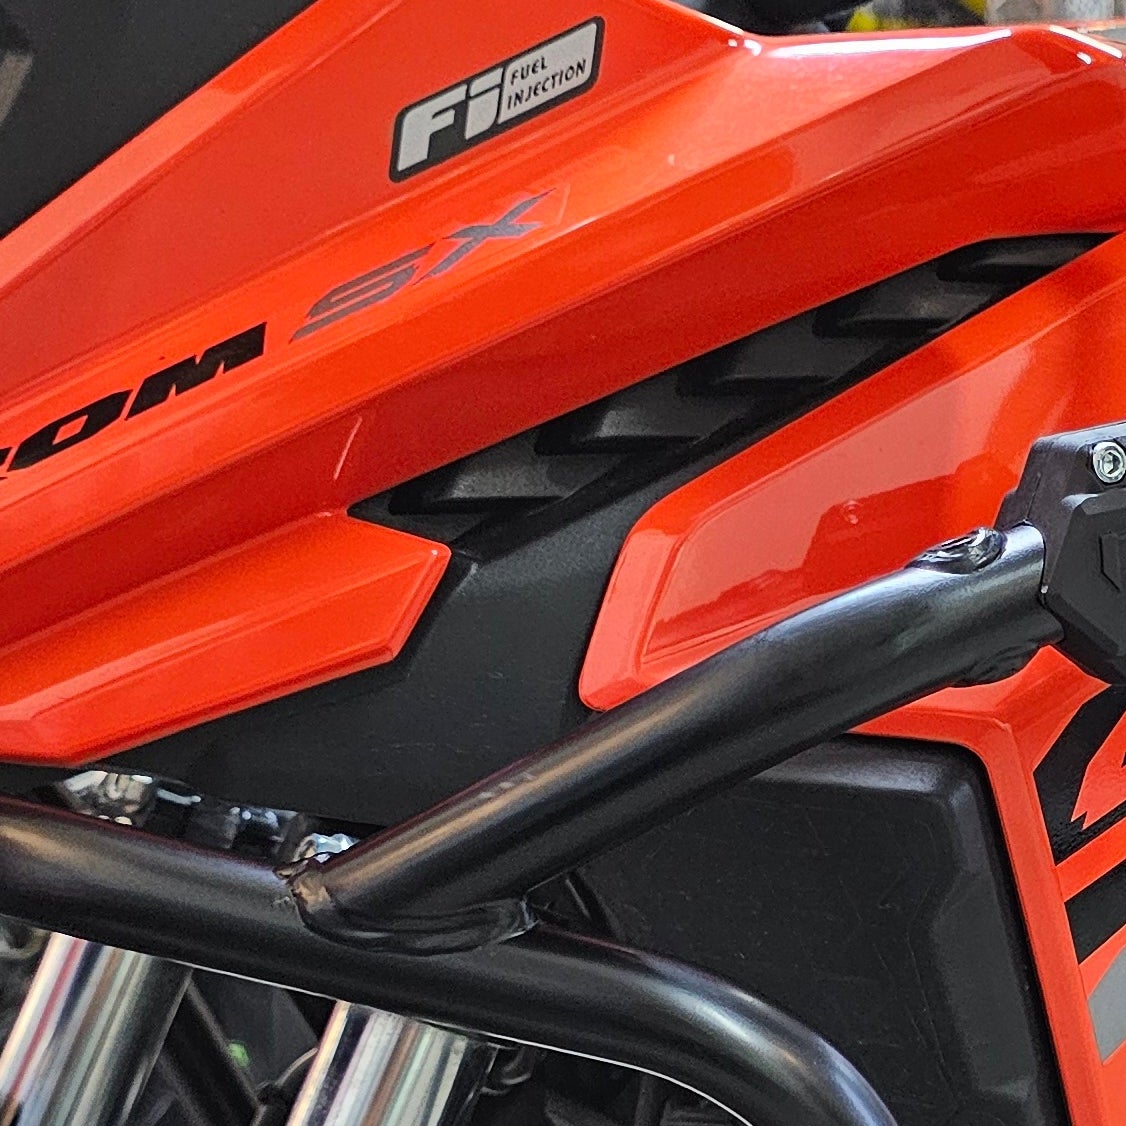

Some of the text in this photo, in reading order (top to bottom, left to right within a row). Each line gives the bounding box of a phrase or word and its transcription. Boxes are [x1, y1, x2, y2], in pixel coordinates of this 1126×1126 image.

[507, 58, 586, 110] INJECTION
[510, 55, 548, 86] FUEL
[0, 187, 557, 480] OM SX
